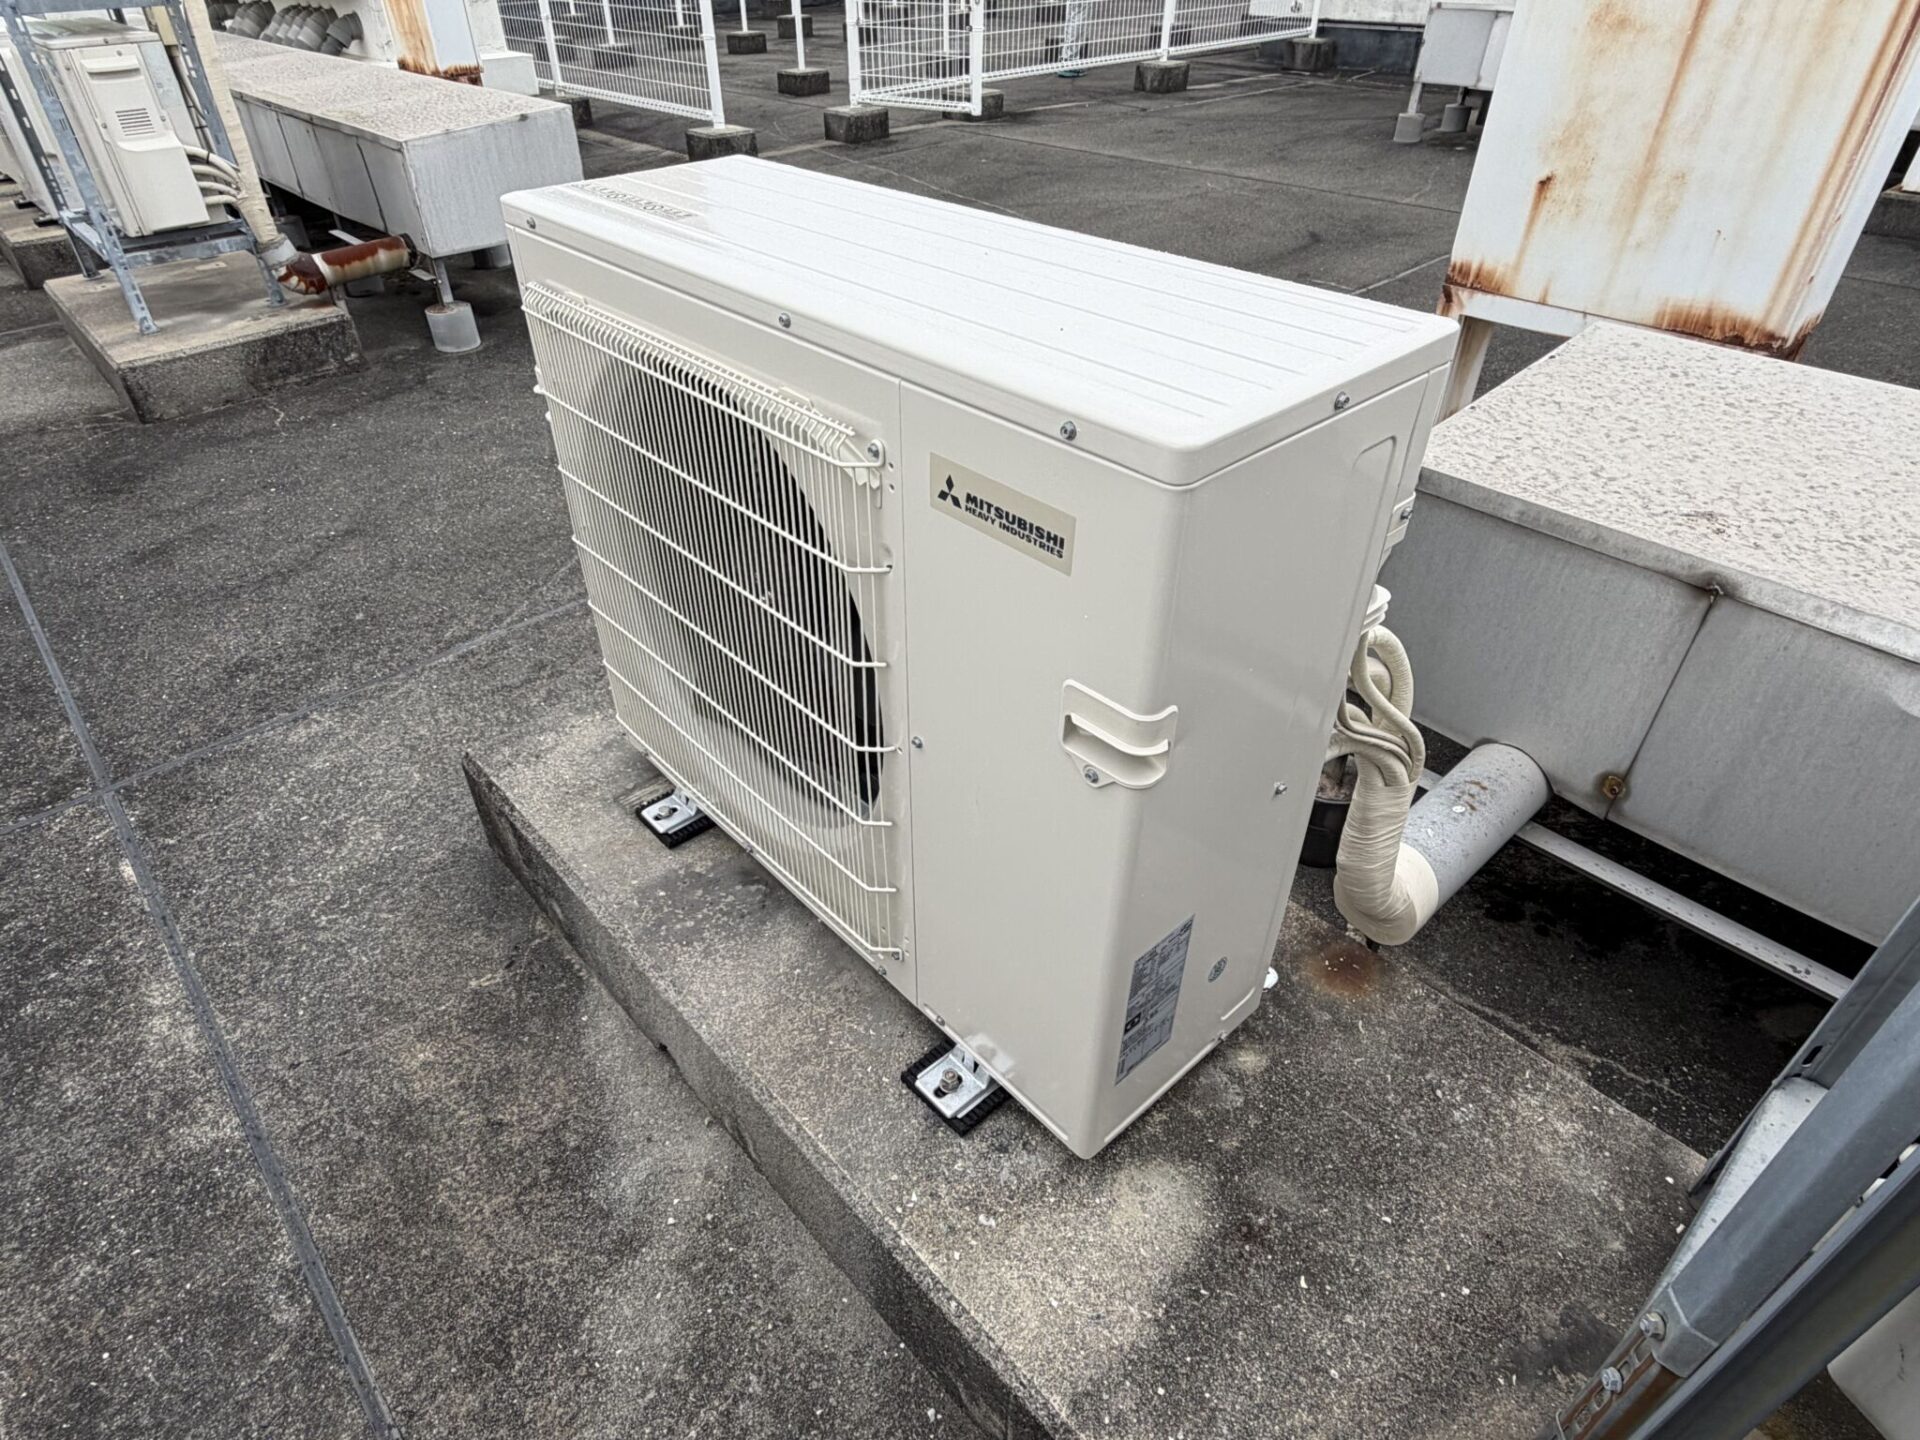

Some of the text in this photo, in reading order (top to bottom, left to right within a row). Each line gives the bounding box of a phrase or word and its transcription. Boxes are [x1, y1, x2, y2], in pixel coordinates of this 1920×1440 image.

[964, 504, 1064, 559] HEAVY INDUSTRIES
[965, 491, 1065, 550] MITSUBISHI
